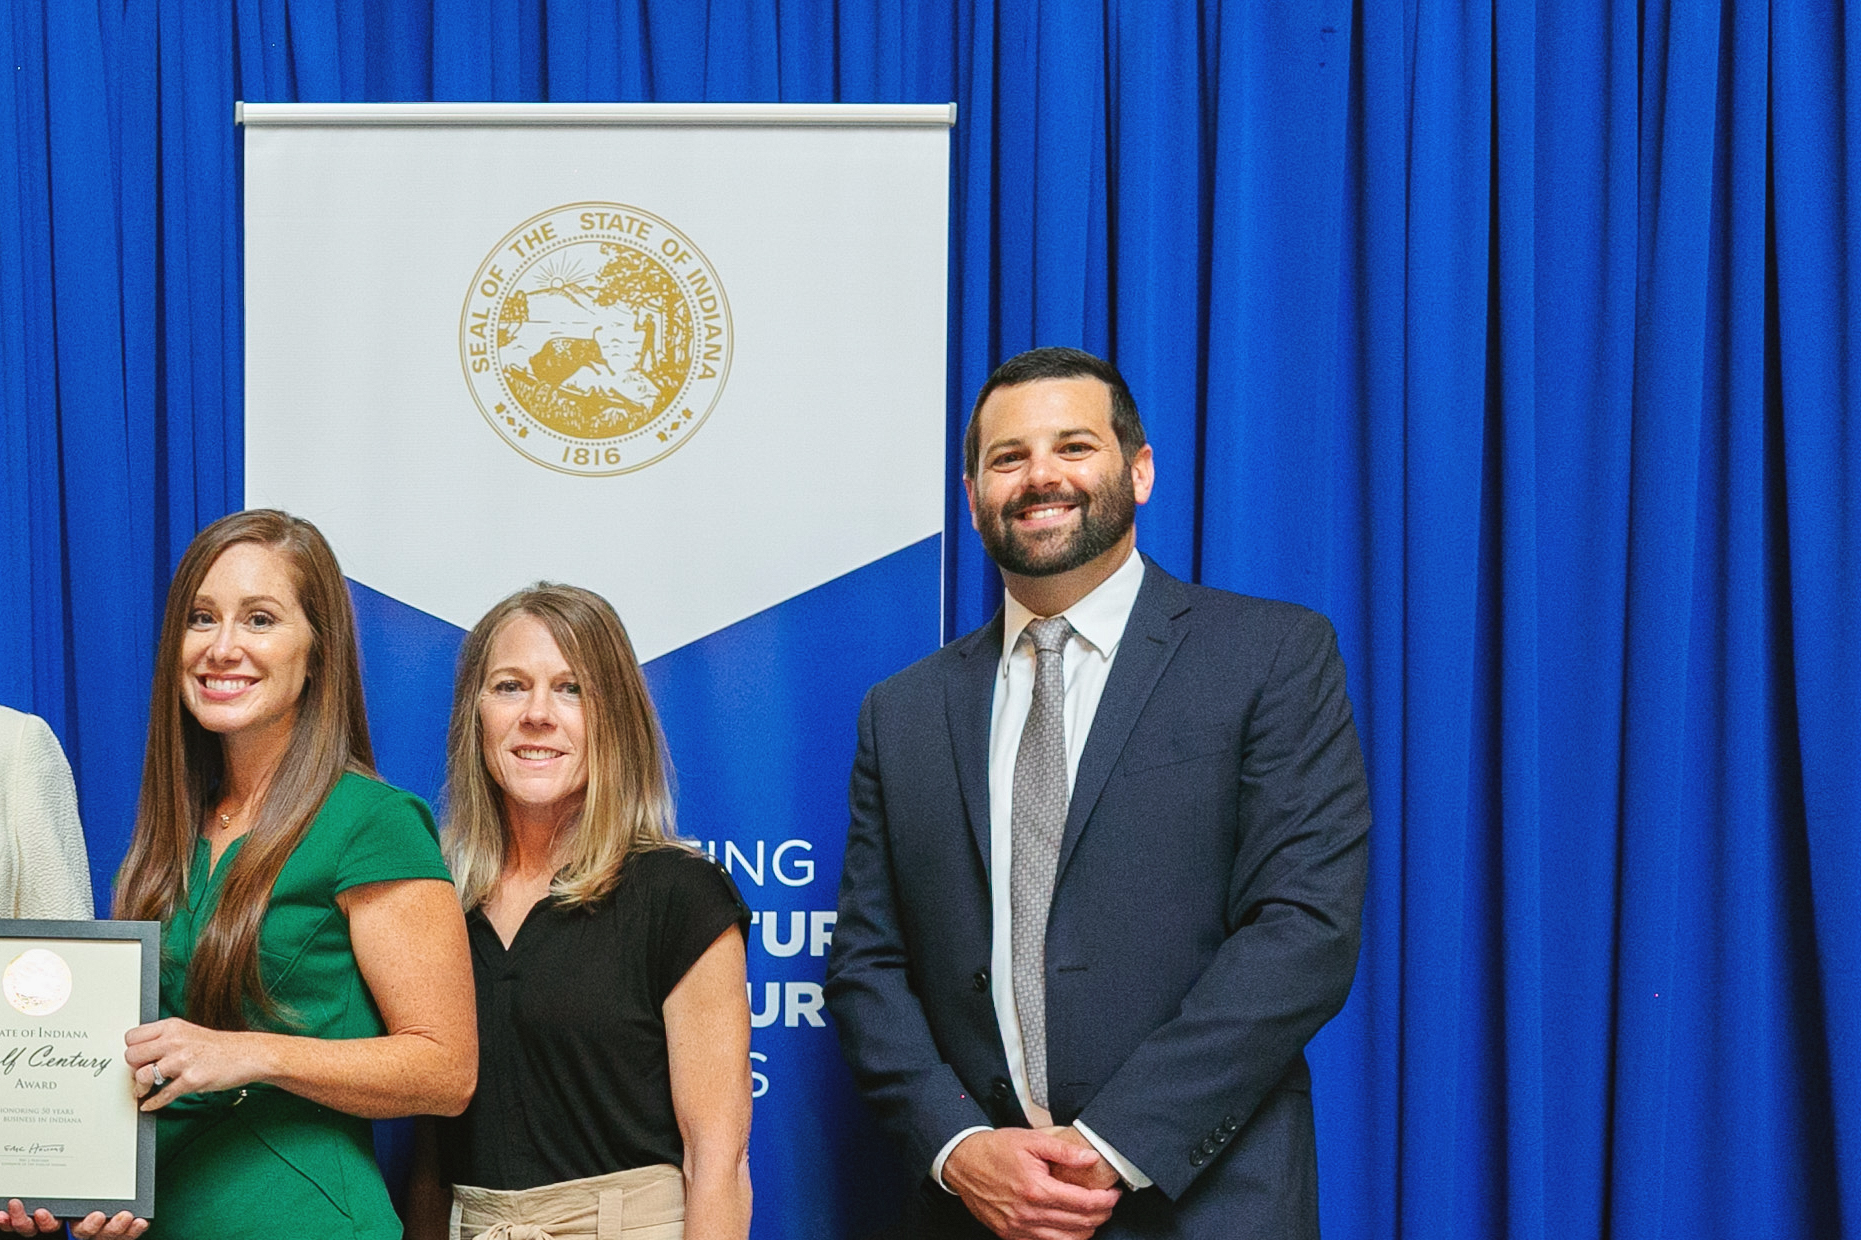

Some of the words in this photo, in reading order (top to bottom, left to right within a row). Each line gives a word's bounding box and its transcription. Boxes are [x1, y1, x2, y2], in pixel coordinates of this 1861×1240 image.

[469, 306, 491, 373] SEAL
[480, 265, 506, 298] OF
[508, 221, 557, 259] THE
[579, 212, 654, 241] STATE
[661, 238, 693, 266] OF
[687, 268, 723, 380] INDIANA
[561, 446, 621, 466] 1816
[686, 839, 815, 887] ING
[20, 1029, 35, 1038] OF
[38, 1026, 89, 1040] INDIANA
[28, 1044, 113, 1078] Century
[14, 1078, 58, 1090] AWARD
[41, 1107, 50, 1115] 50
